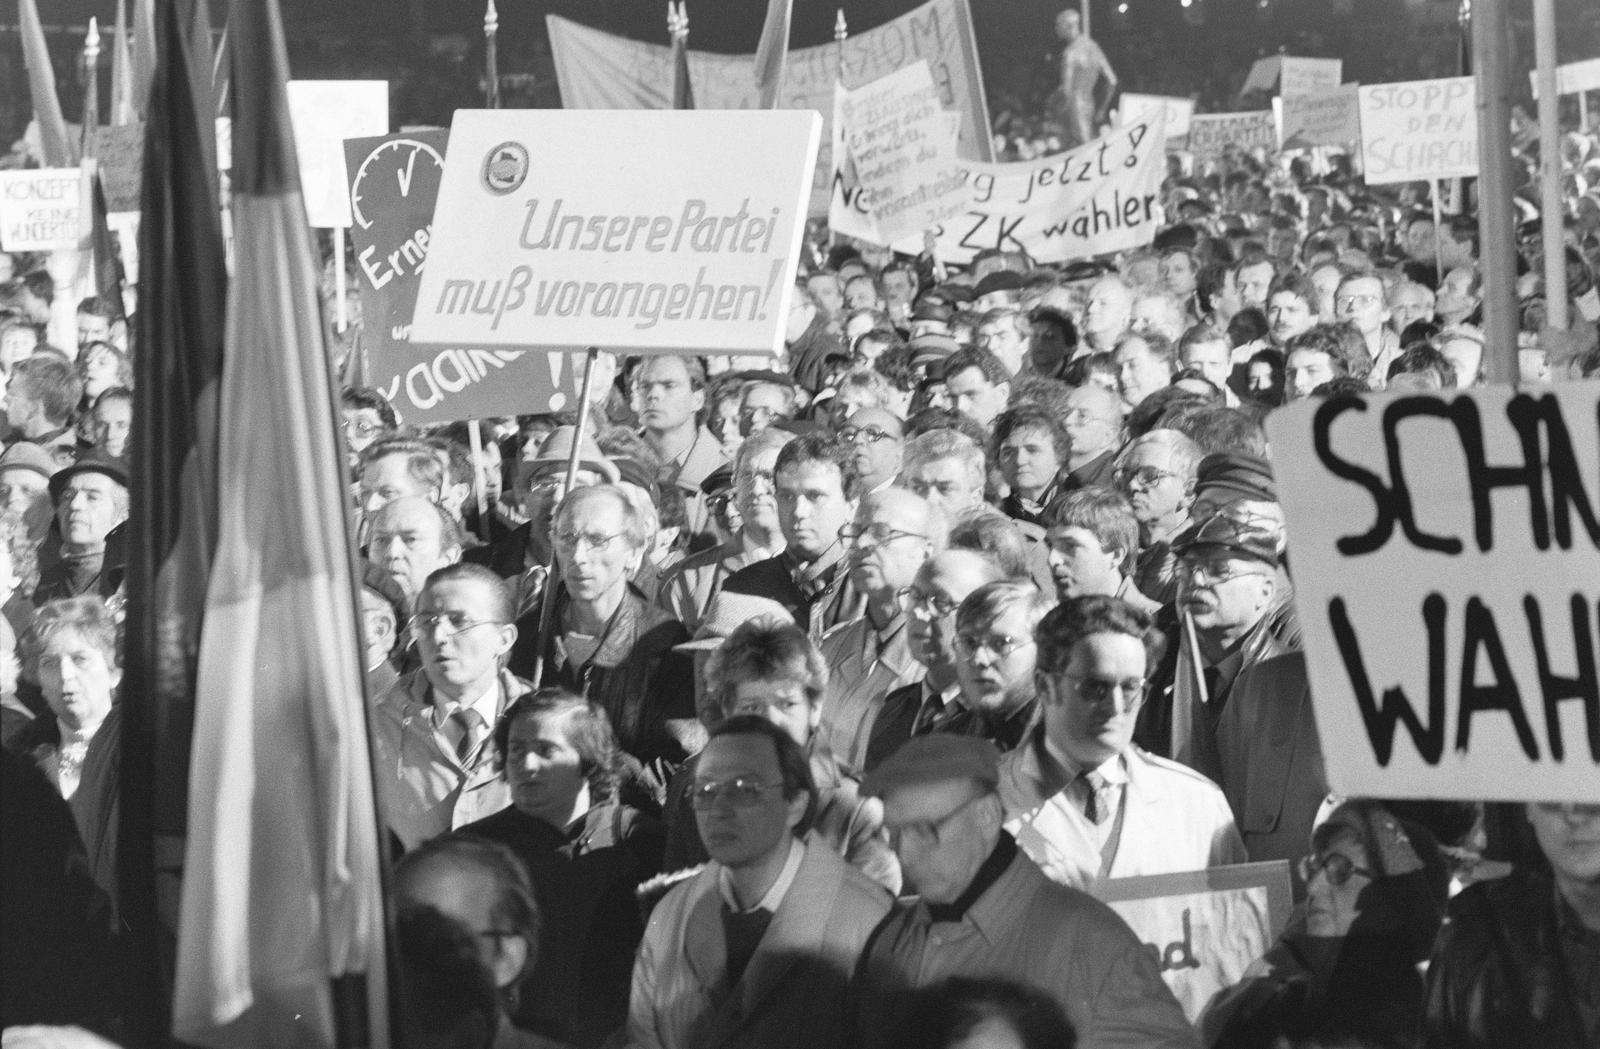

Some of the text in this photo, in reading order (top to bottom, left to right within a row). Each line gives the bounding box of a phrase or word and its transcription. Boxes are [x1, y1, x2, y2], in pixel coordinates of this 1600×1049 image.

[1369, 82, 1468, 110] STOPP
[1407, 112, 1466, 133] DEN
[519, 198, 780, 253] Unsere Partei
[959, 211, 1026, 252] ZK
[436, 258, 785, 330] muß vorangehen!
[1328, 591, 1600, 768] WAH
